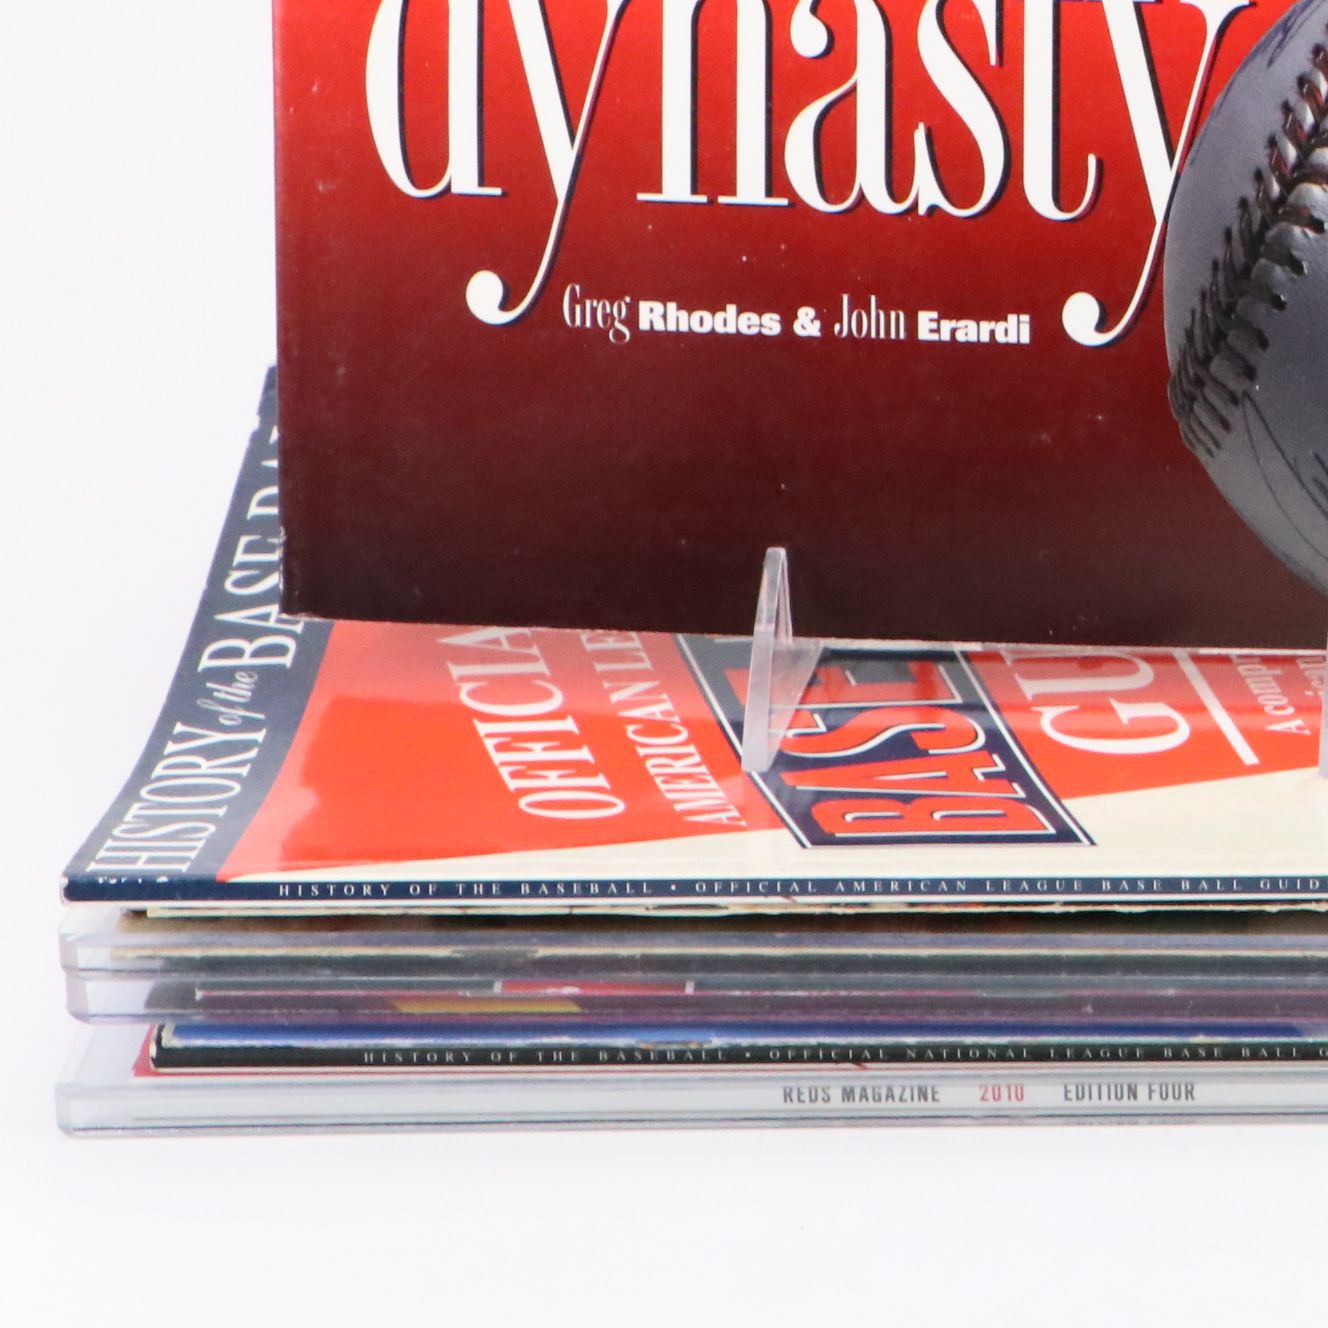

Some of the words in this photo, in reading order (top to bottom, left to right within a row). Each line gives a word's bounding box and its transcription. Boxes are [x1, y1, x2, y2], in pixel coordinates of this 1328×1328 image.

[562, 283, 632, 343] Greg
[638, 302, 781, 336] Rhodes
[792, 306, 822, 337] &
[835, 294, 906, 341] John
[917, 312, 1031, 344] Erardi
[206, 670, 259, 702] the
[197, 697, 266, 726] of
[1265, 718, 1312, 737] A
[603, 680, 748, 827] AMERICAN
[86, 721, 267, 873] HISTORY
[278, 882, 392, 896] HISTORY
[409, 882, 437, 896] OF
[456, 882, 501, 896] THE
[520, 880, 653, 895] BASEBALL
[695, 879, 817, 894] OFFICIAL
[835, 878, 967, 893] AMERICAN
[986, 877, 1084, 892] LEAGUE
[1102, 876, 1163, 892] BASE
[1181, 876, 1243, 891] BALL
[364, 1052, 472, 1064] HISTORY
[490, 1050, 518, 1063] OF
[537, 1049, 580, 1063] THE
[599, 1049, 727, 1062] BASEBALL
[769, 1048, 889, 1062] OFFICIAL
[906, 1047, 1031, 1061] NATIONAL
[1050, 1047, 1145, 1060] LEAGUE
[1163, 1046, 1223, 1060] BASE
[1241, 1046, 1299, 1059] BALL
[782, 1085, 831, 1104] REDS
[841, 1084, 942, 1103] MAGAZINE
[979, 1084, 1025, 1102] 2010
[1063, 1082, 1138, 1102] EDITION
[1147, 1083, 1196, 1102] FOUR
